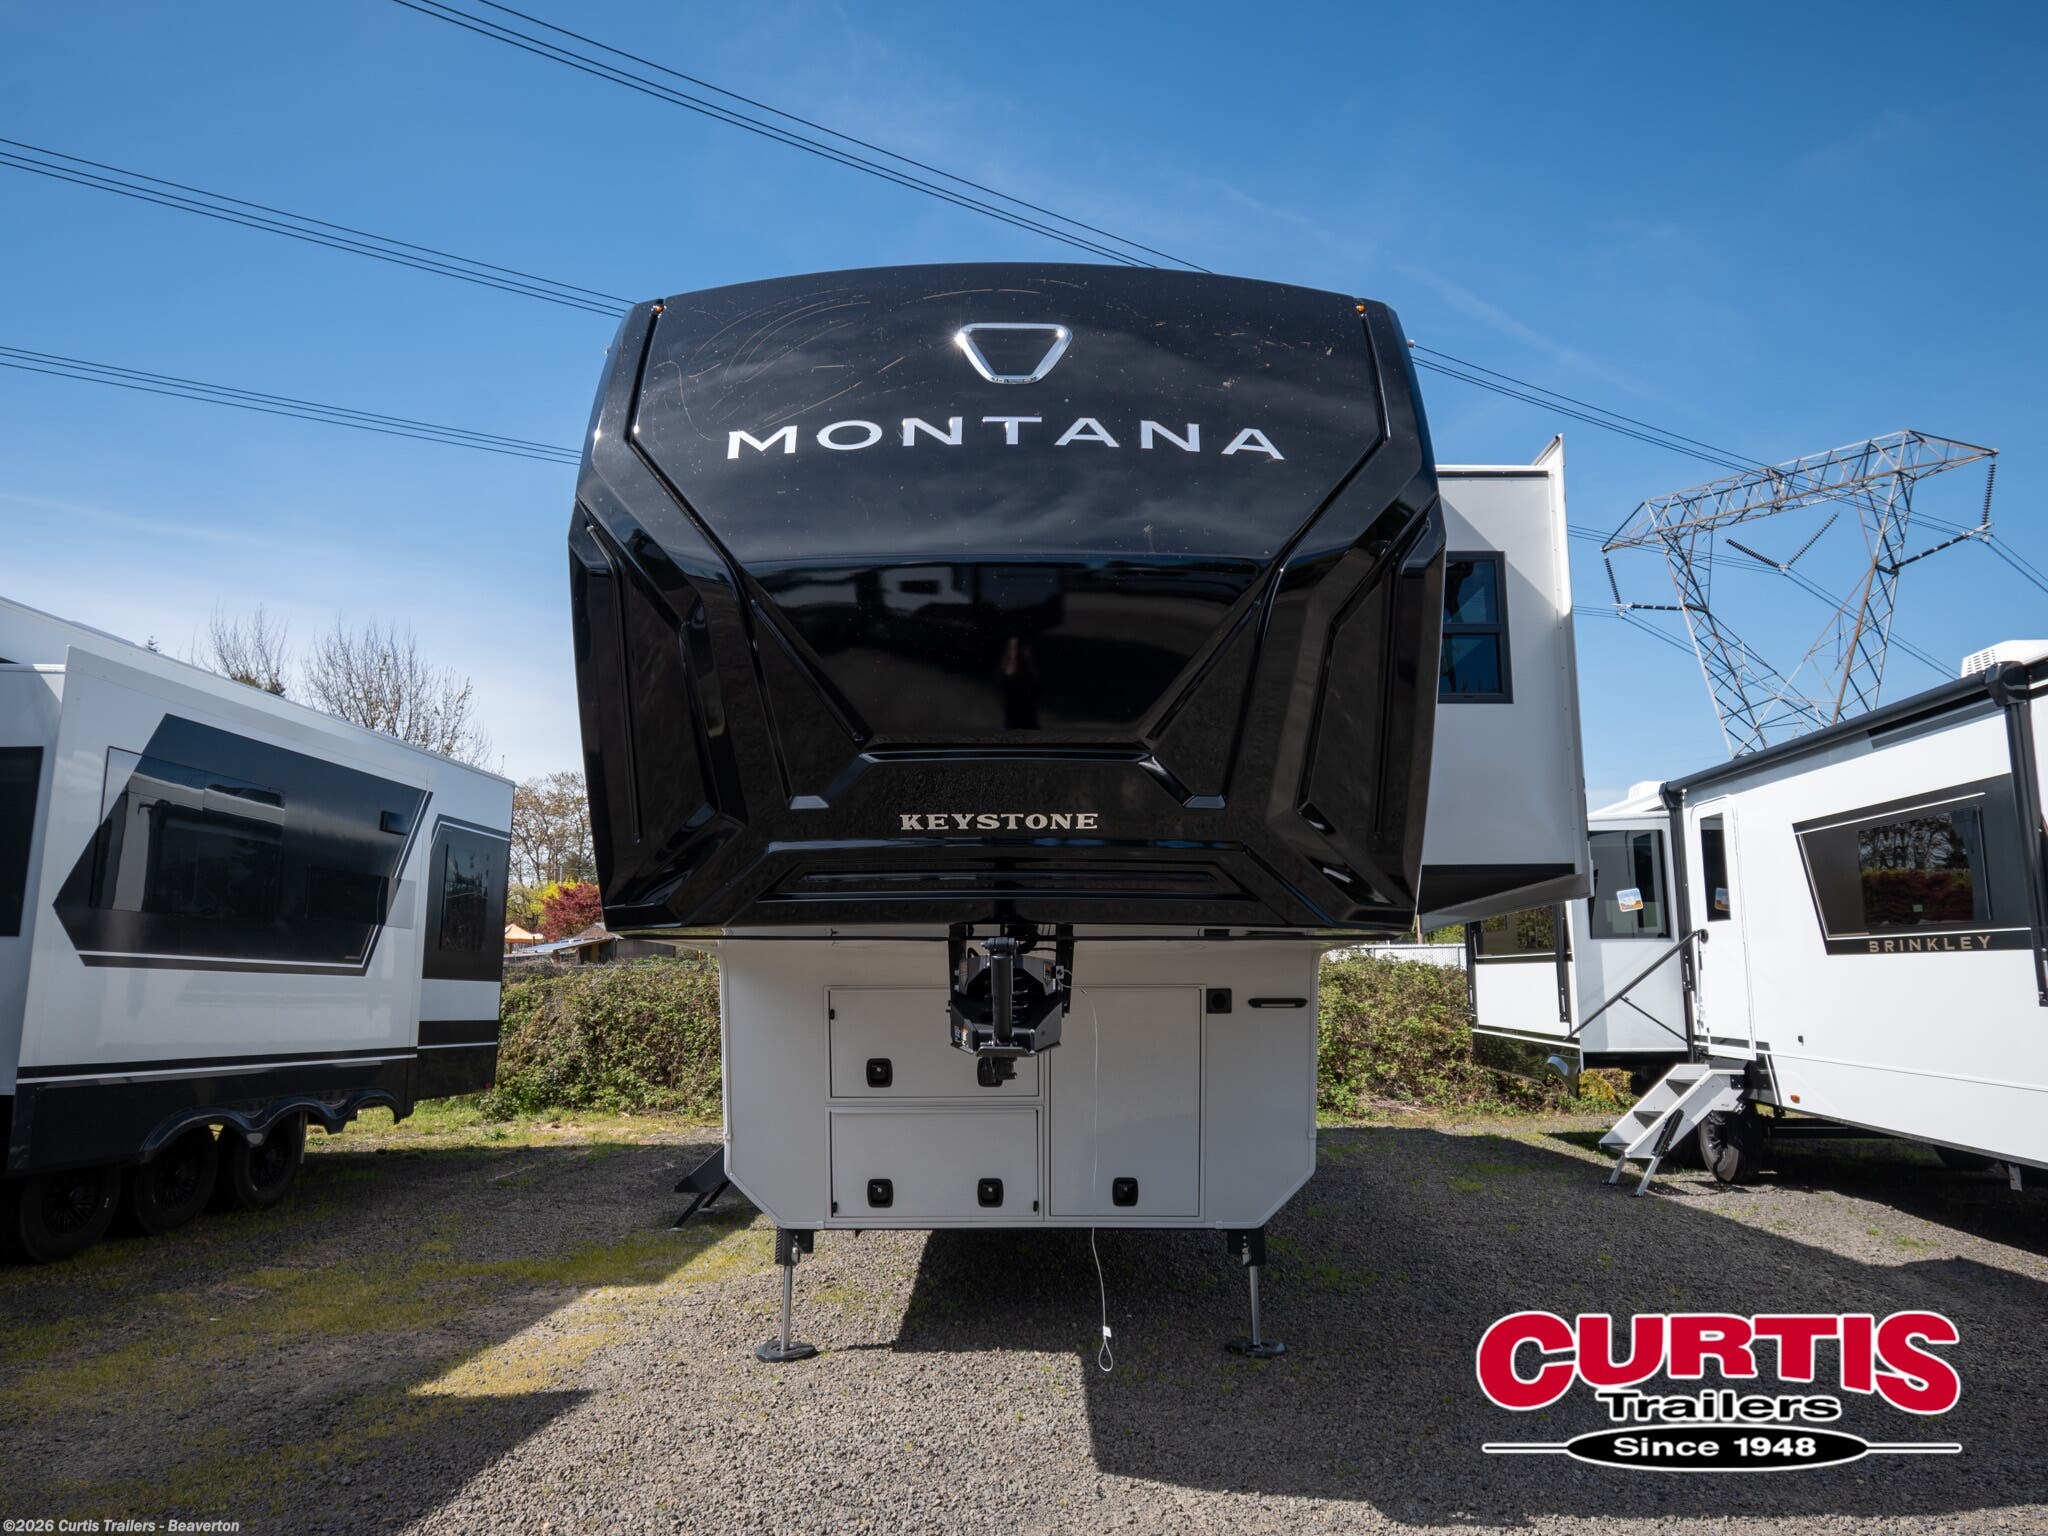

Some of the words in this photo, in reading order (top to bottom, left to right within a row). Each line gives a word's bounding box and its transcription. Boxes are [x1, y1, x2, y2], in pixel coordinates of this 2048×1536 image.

[727, 417, 1285, 459] MONTANA
[900, 813, 1099, 830] KEYSTONE
[1869, 935, 1991, 953] BRINKLEY
